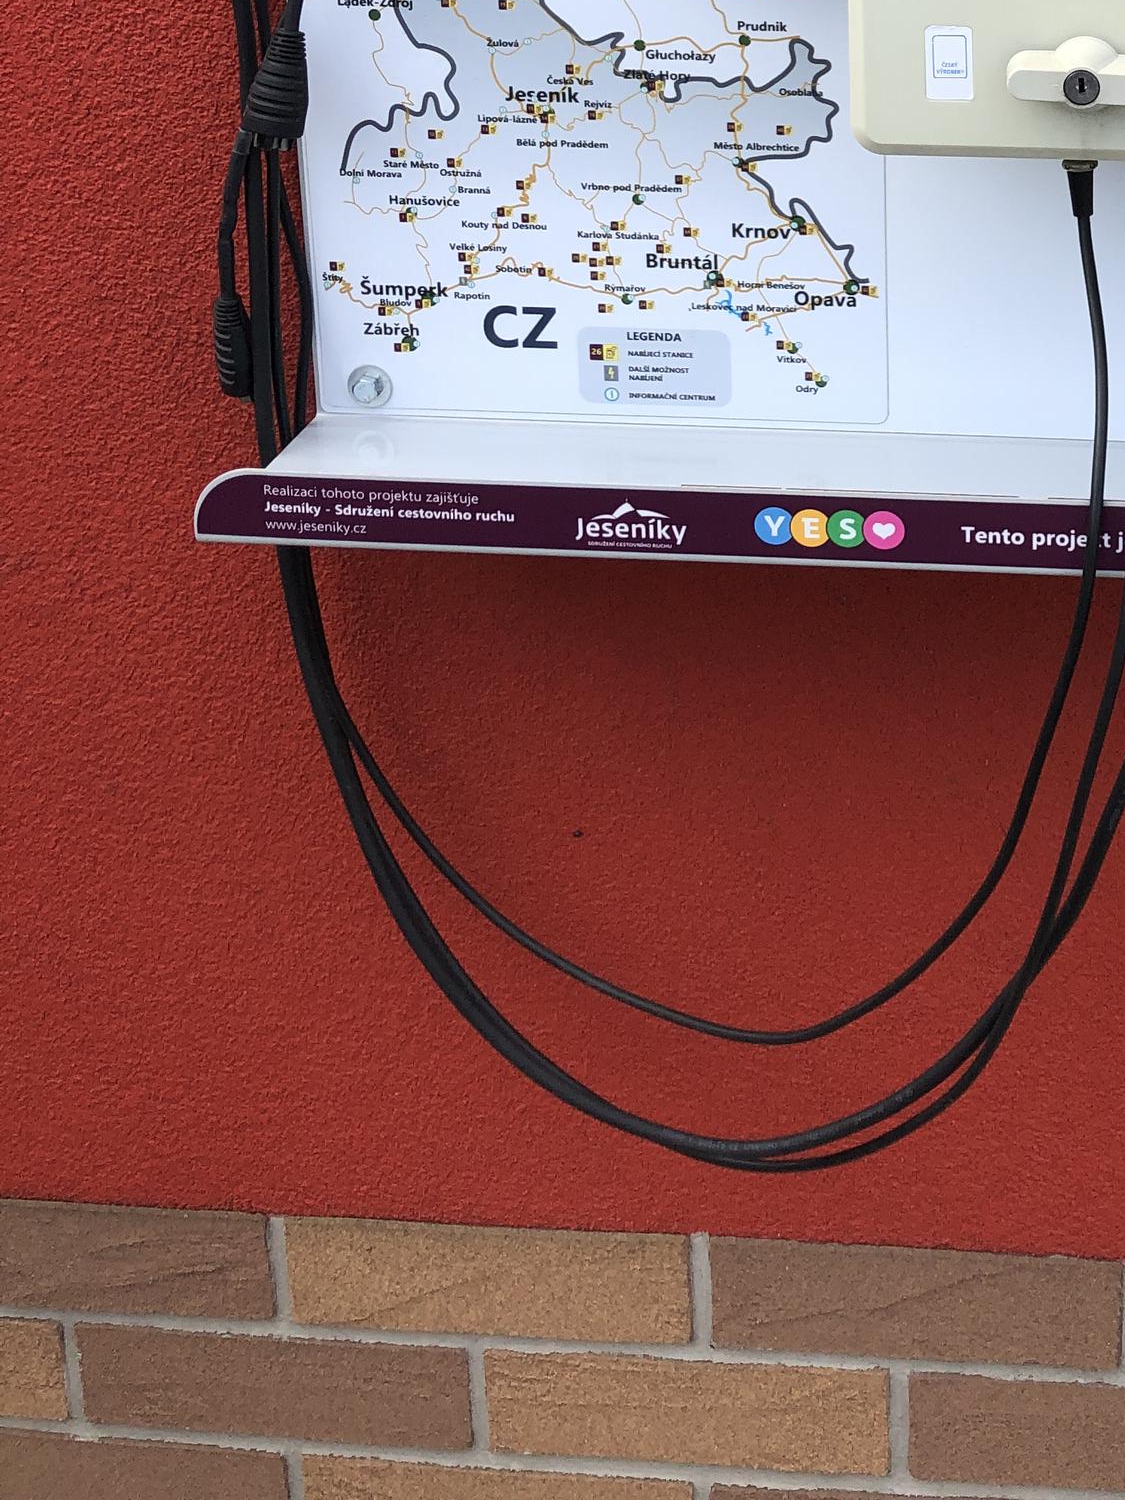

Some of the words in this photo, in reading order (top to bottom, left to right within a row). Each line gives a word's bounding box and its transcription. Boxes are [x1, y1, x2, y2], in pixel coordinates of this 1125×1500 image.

[737, 21, 787, 32] Prudnik
[646, 50, 716, 64] Głuchołazy
[505, 86, 579, 104] Jeseník
[389, 194, 460, 207] Hanušovice
[732, 223, 791, 240] Krnov
[646, 253, 718, 270] Bruntál
[361, 276, 447, 301] Šumperk
[794, 291, 857, 310] Opava
[364, 323, 420, 336] Zábřeh
[483, 305, 558, 349] CZ
[627, 332, 682, 342] LEGENDA
[796, 385, 818, 394] Odry
[263, 484, 317, 498] Realizaci
[321, 488, 365, 499] tohoto
[369, 490, 421, 503] projektu
[426, 492, 479, 505] zajišťuje
[264, 502, 321, 517] Jeseníky
[335, 504, 394, 517] Sdružení
[398, 508, 472, 521] cestovního
[476, 511, 515, 522] ruchu
[266, 520, 367, 535] www.jeseniky.cz
[575, 517, 687, 544] Jeseníky
[961, 526, 1025, 545] Tento
[1032, 530, 1111, 550] projet
